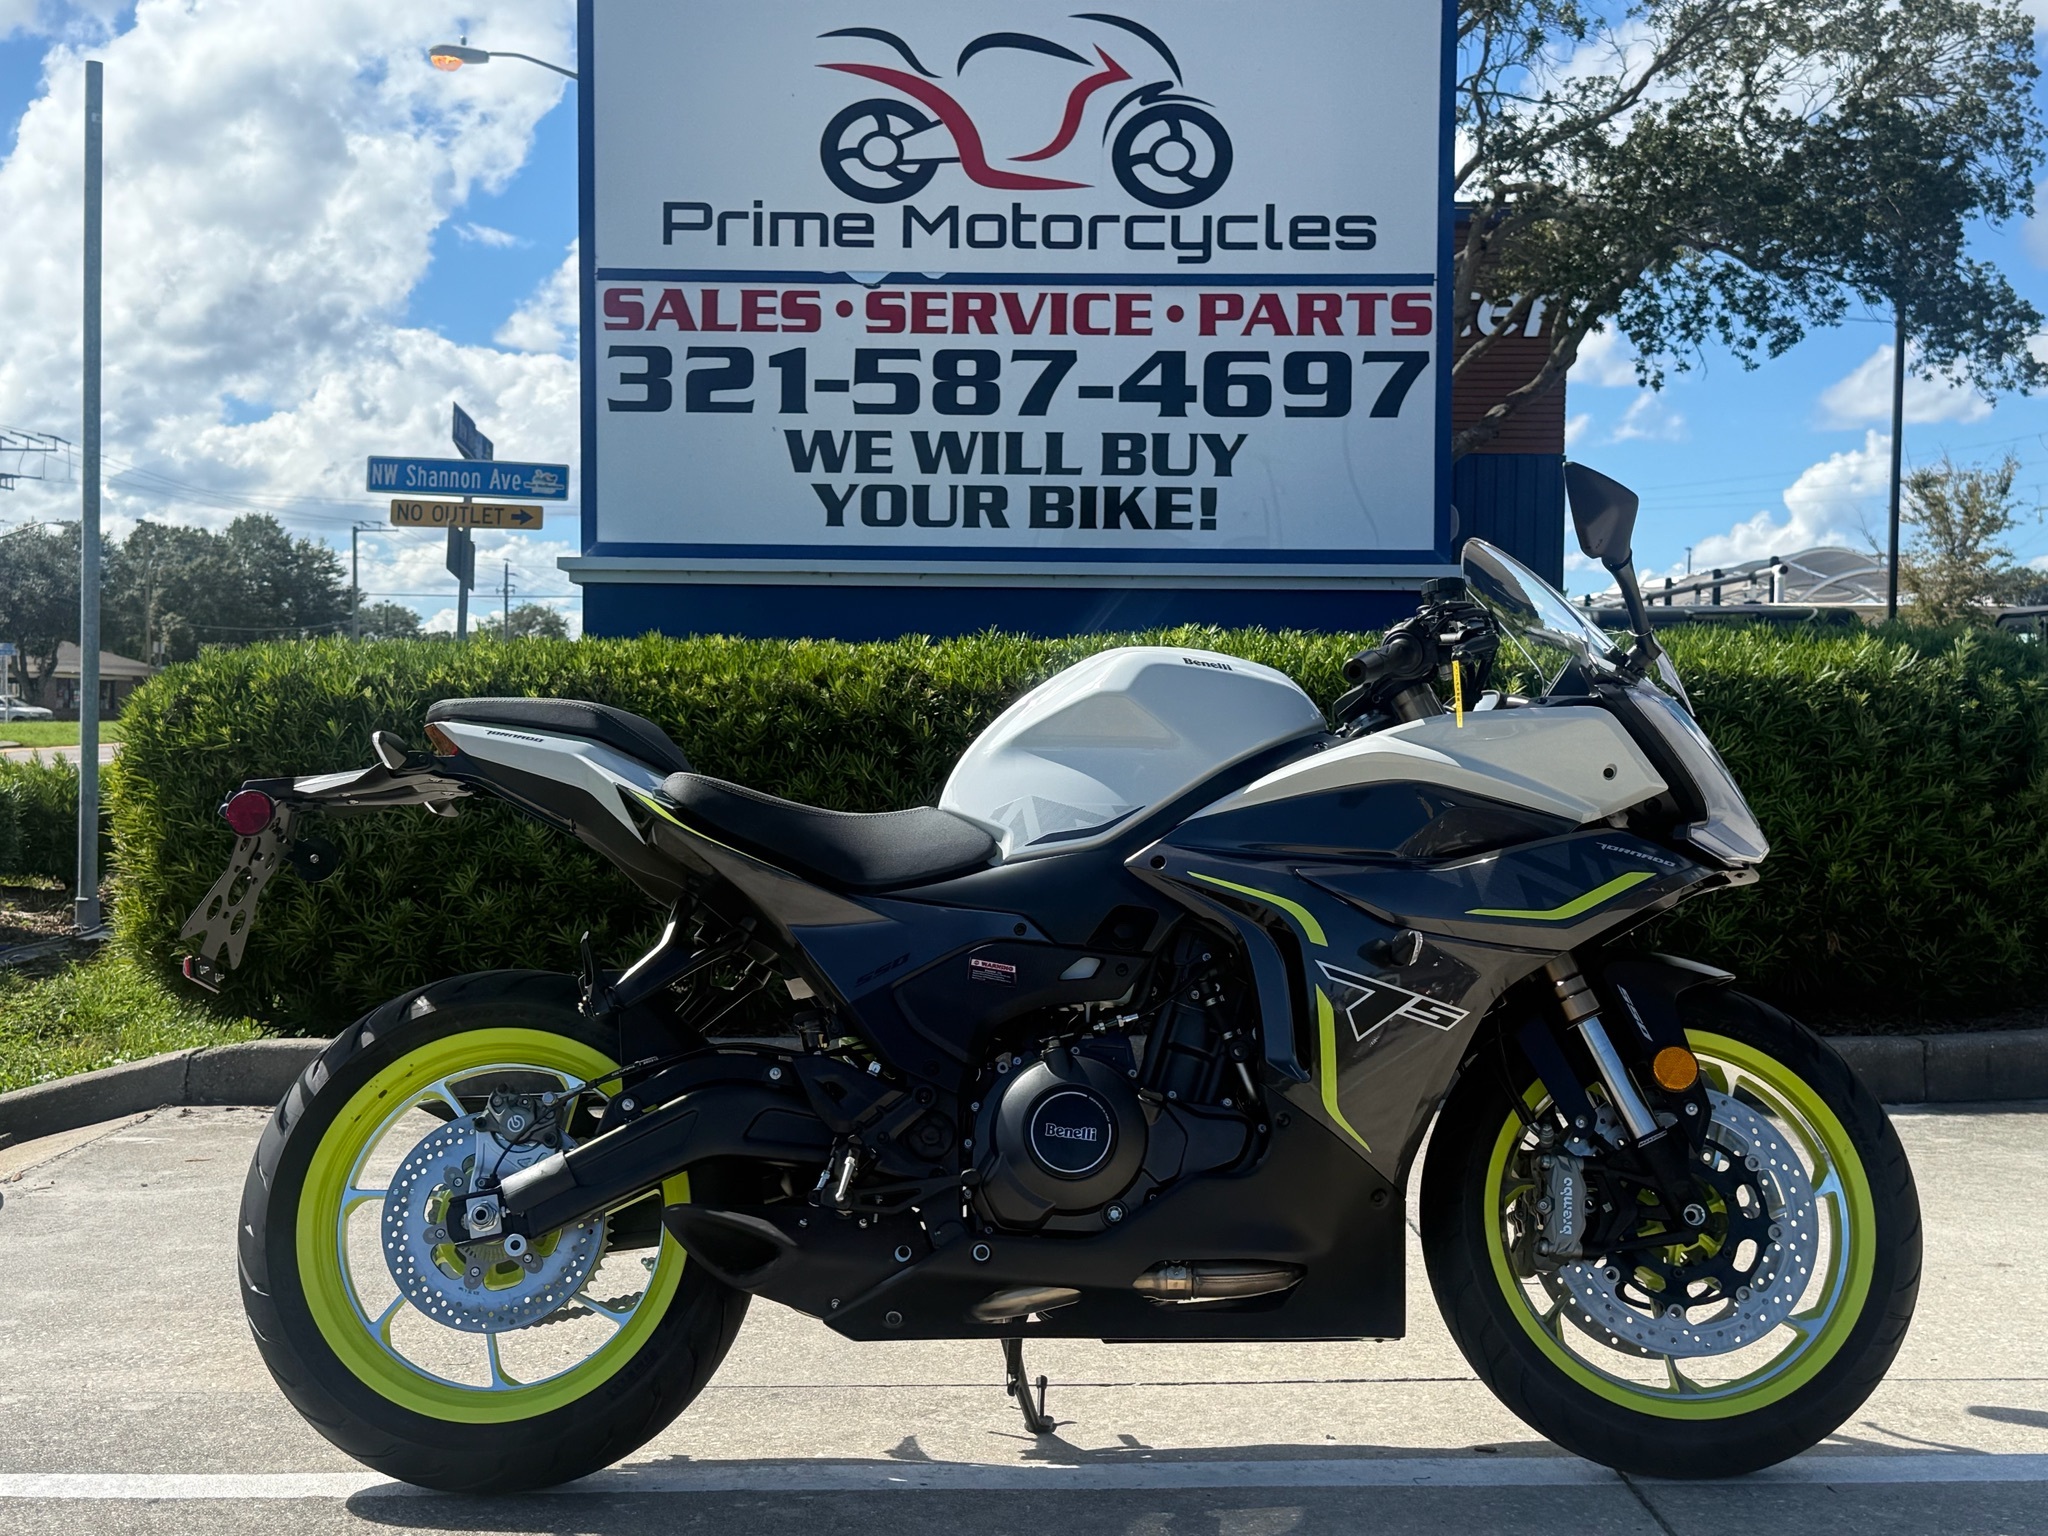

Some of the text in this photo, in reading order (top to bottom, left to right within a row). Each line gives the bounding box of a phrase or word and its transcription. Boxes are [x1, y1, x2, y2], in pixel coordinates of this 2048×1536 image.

[662, 200, 1378, 265] Prime Motorcycles
[603, 287, 1434, 337] SALES SERVICE PARTS
[607, 344, 1431, 419] 321-587-4697
[783, 429, 1249, 478] WE WILL BUY
[371, 463, 522, 492] NW Shannon Ave
[396, 503, 505, 526] NO OUTLET
[810, 483, 1219, 531] YOUR BIKE!
[1181, 656, 1234, 672] Benelli
[854, 952, 911, 988] 550
[980, 960, 1014, 972] WARNING
[1044, 1122, 1098, 1142] Benelli
[1559, 1176, 1574, 1236] brembo
